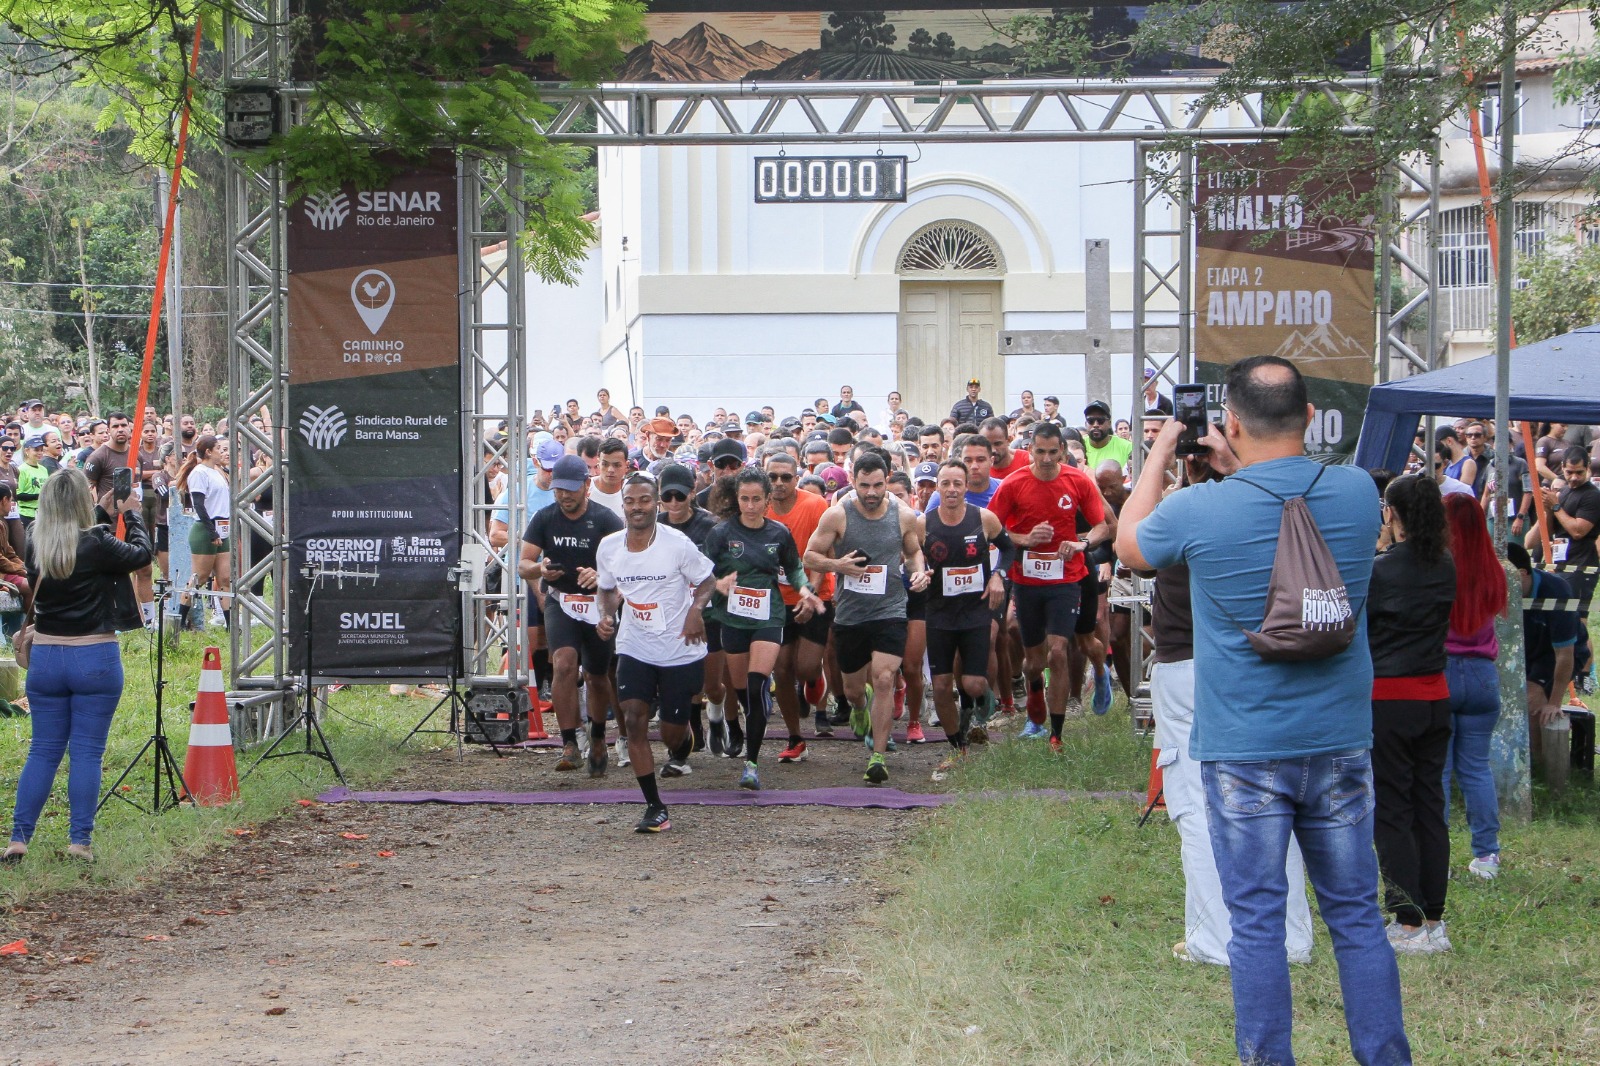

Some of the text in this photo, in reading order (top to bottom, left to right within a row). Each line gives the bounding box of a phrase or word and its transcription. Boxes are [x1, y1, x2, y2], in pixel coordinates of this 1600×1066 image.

[357, 191, 441, 212] SENAR
[356, 214, 435, 226] Rio de Janeiro
[1207, 267, 1263, 286] ETAPA 2
[1206, 290, 1332, 326] AMPARO
[343, 340, 404, 351] CAMINHO
[343, 353, 360, 363] DA
[1207, 383, 1227, 402] ETA
[355, 415, 447, 426] Sindicato Rural de
[355, 430, 420, 440] Barra Mansa
[356, 511, 413, 519] INSTITUCIONAL
[306, 539, 375, 550] GOVERNO
[411, 537, 442, 546] Barra
[553, 536, 577, 547] WTR
[407, 547, 446, 556] Mansa
[1034, 561, 1052, 571] 617
[954, 576, 973, 586] 614
[738, 596, 760, 609] 588
[571, 604, 589, 614] 497
[1302, 599, 1344, 623] RURAL
[340, 612, 405, 629] SMJEL
